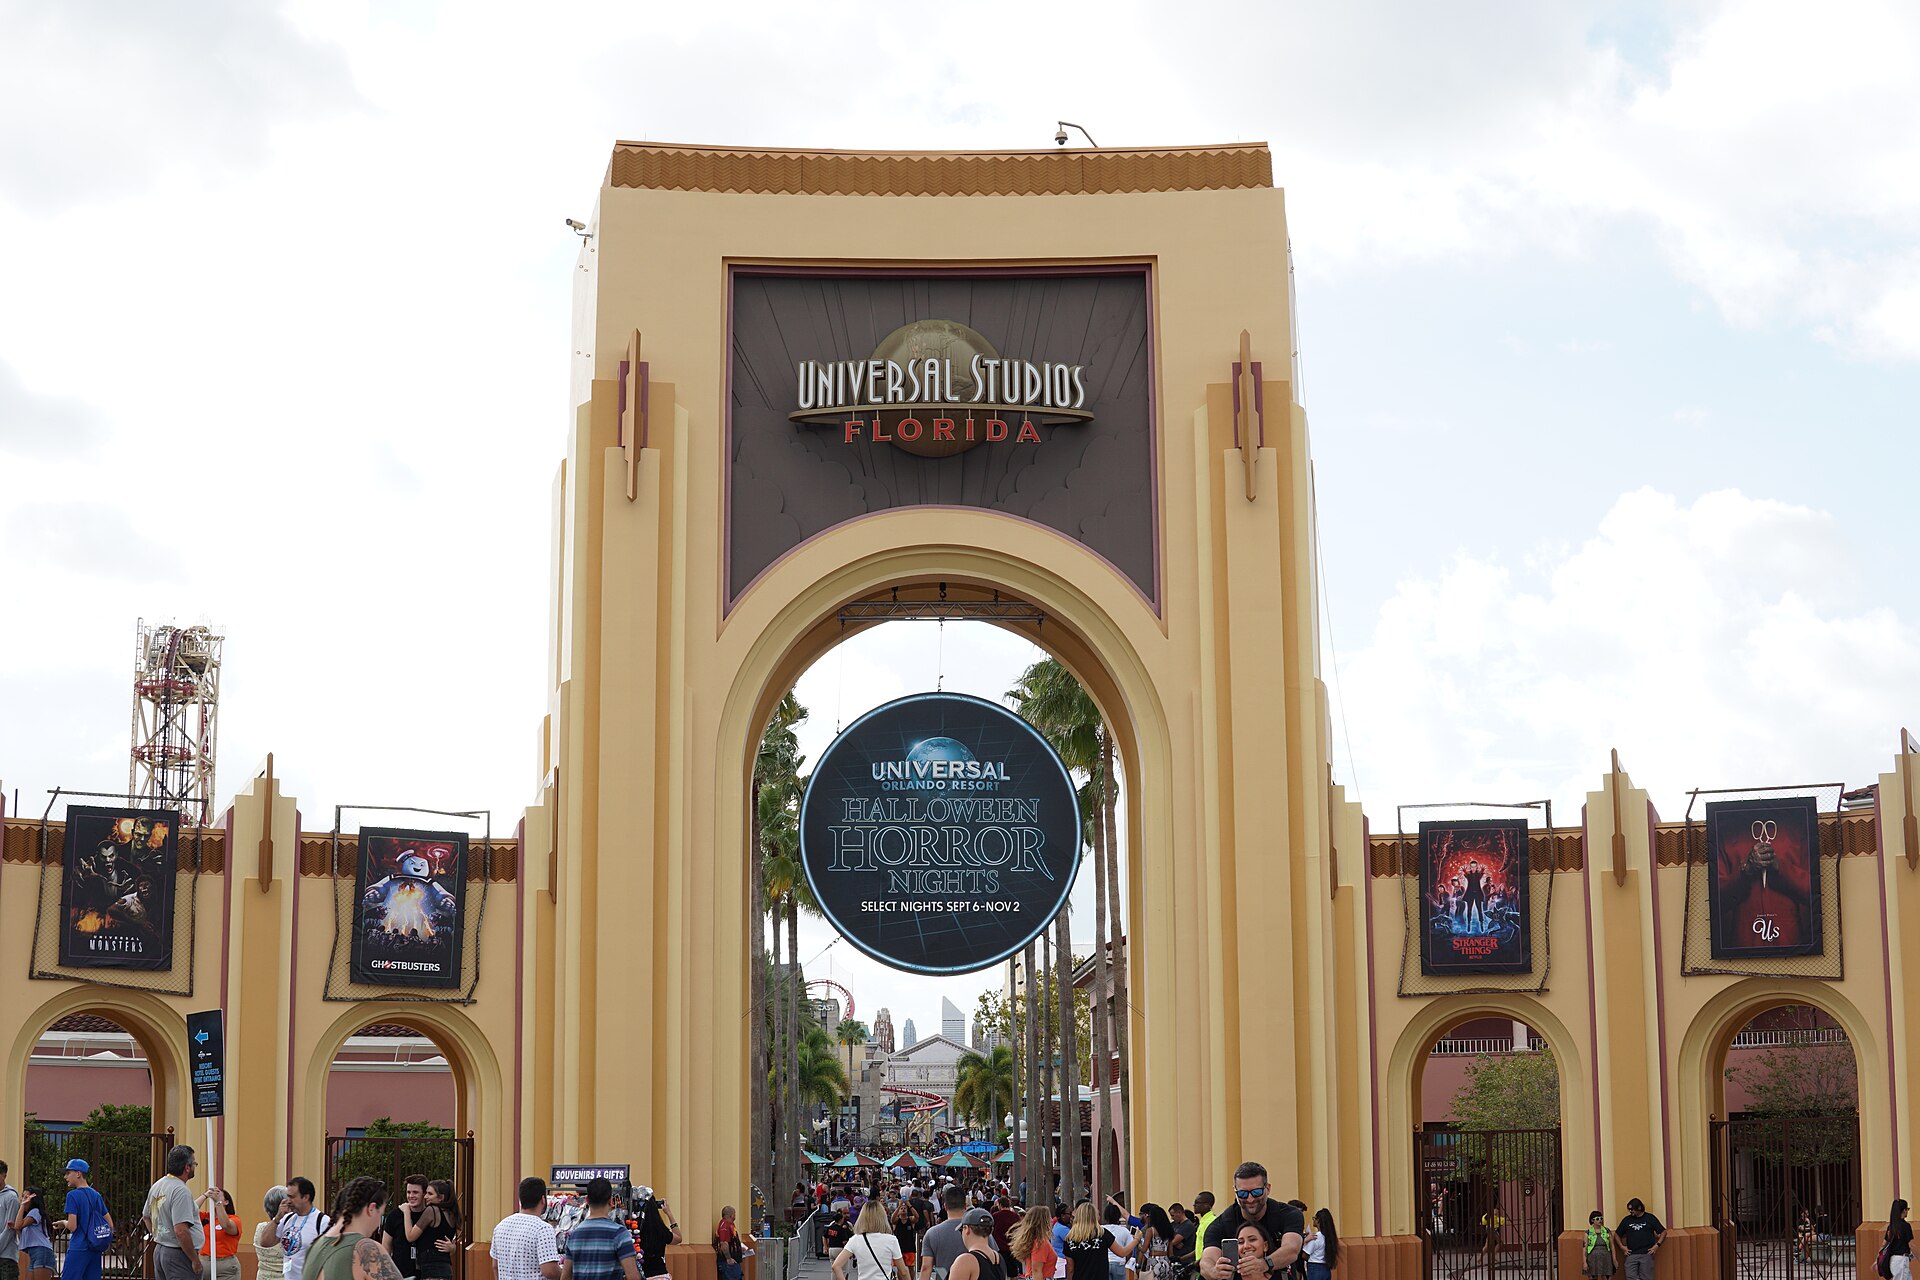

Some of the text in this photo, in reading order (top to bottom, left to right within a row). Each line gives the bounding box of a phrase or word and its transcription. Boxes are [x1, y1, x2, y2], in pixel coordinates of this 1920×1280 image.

[798, 354, 1086, 410] UNIVERSAL STUDIOS
[844, 418, 1042, 444] FLORIDA
[871, 760, 1011, 782] UNIVERSAL
[881, 781, 1000, 792] ORLANDO RESORT
[841, 797, 1040, 823] HALLOWEEN
[827, 825, 1055, 882] HORROR
[887, 869, 1000, 895] NIGHTS
[861, 901, 897, 912] SELECT
[900, 901, 944, 912] NIGHTS
[947, 901, 972, 912] SEPT
[1752, 918, 1780, 942] Us
[89, 939, 143, 953] MONSTERS
[1452, 937, 1499, 949] STRANGER
[1461, 947, 1492, 955] THINGS
[555, 1170, 595, 1180] SOUVENIRS
[603, 1170, 624, 1180] GIFTS
